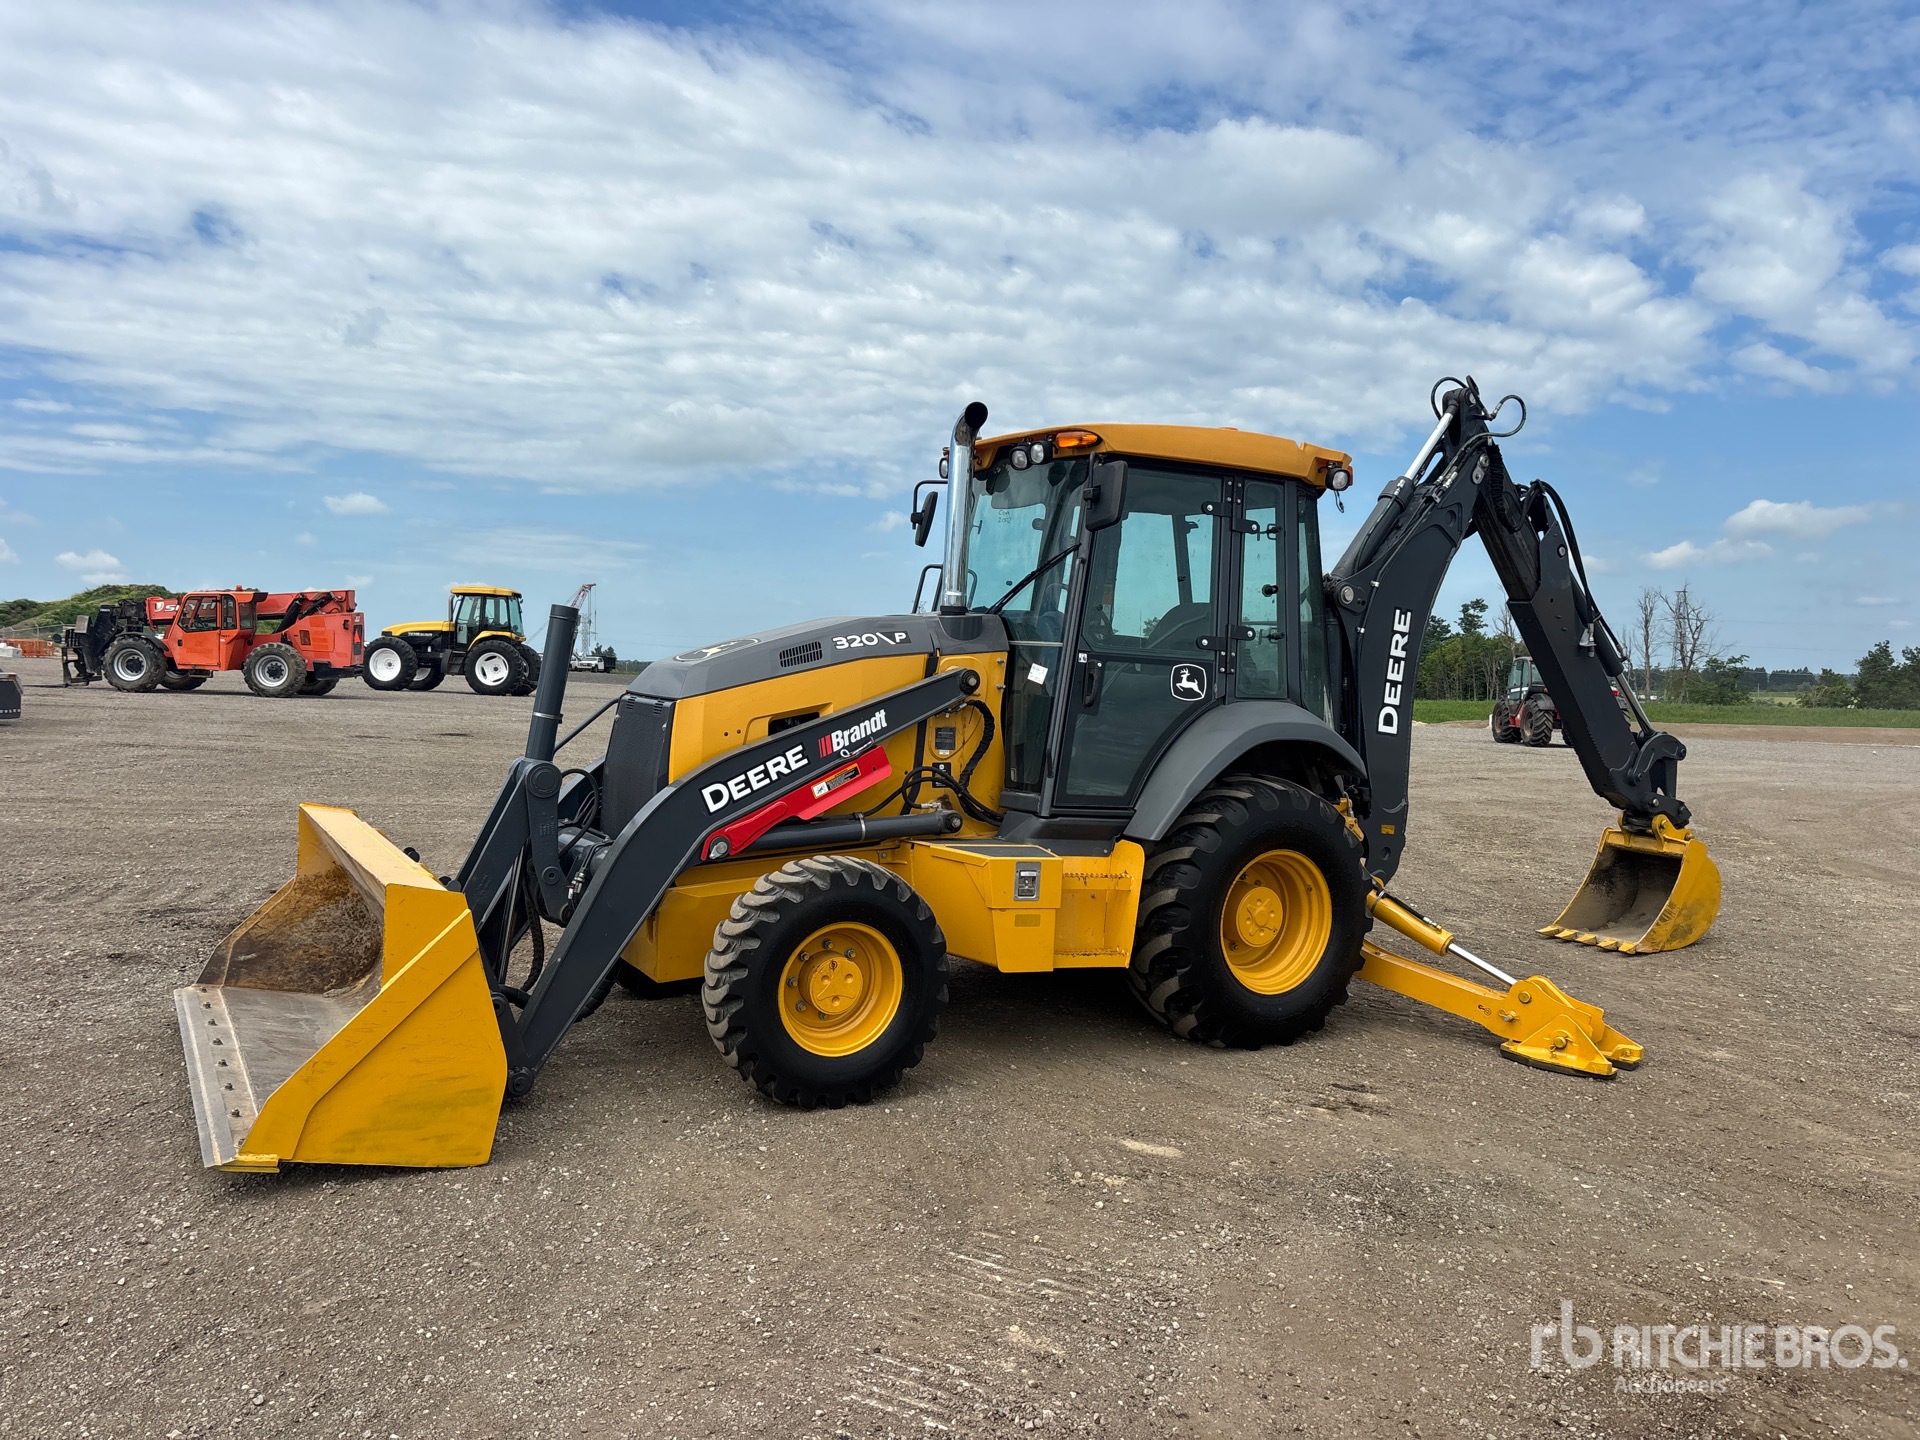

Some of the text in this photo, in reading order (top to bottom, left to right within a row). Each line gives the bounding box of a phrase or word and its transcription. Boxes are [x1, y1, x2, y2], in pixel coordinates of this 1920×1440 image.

[1378, 609, 1412, 734] DEERE
[830, 708, 887, 753] Brandt
[701, 744, 809, 814] DEERE
